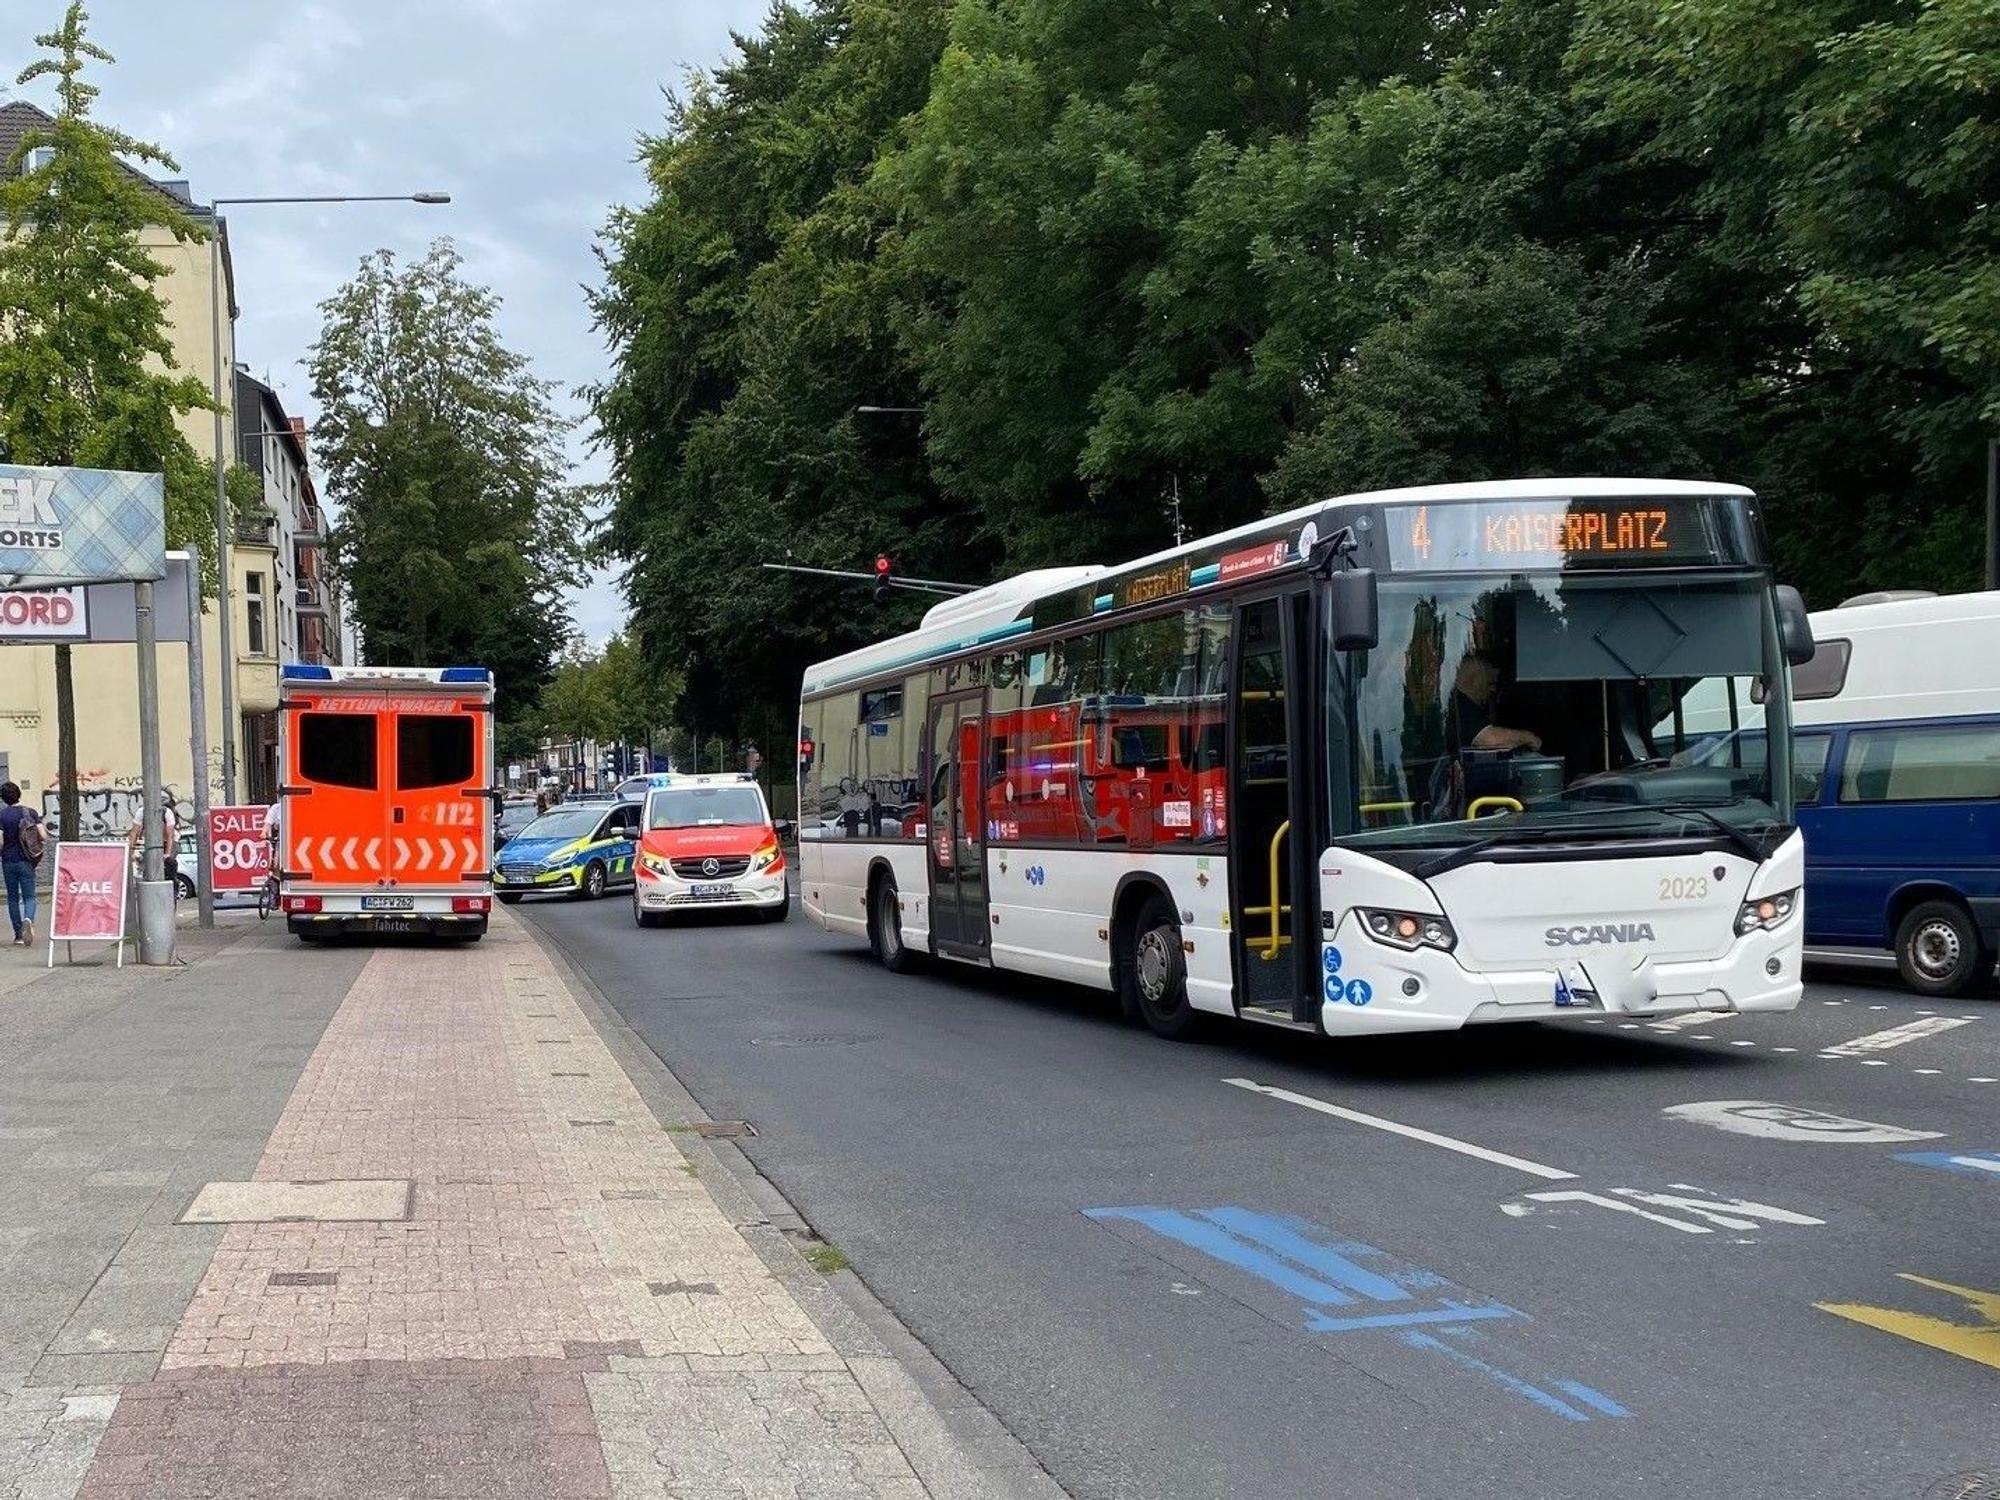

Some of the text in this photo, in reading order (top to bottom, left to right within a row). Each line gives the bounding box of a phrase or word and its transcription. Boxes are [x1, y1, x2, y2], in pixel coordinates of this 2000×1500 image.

[1411, 505, 1669, 559] 4 KAISERPLATZ
[0, 595, 74, 625] ORD
[317, 698, 456, 713] RETTUNGSWAGEN
[213, 814, 265, 833] SALE
[435, 802, 474, 826] 112
[69, 881, 113, 894] SALE
[1659, 877, 1708, 900] 2023
[1544, 923, 1657, 947] SCANIA
